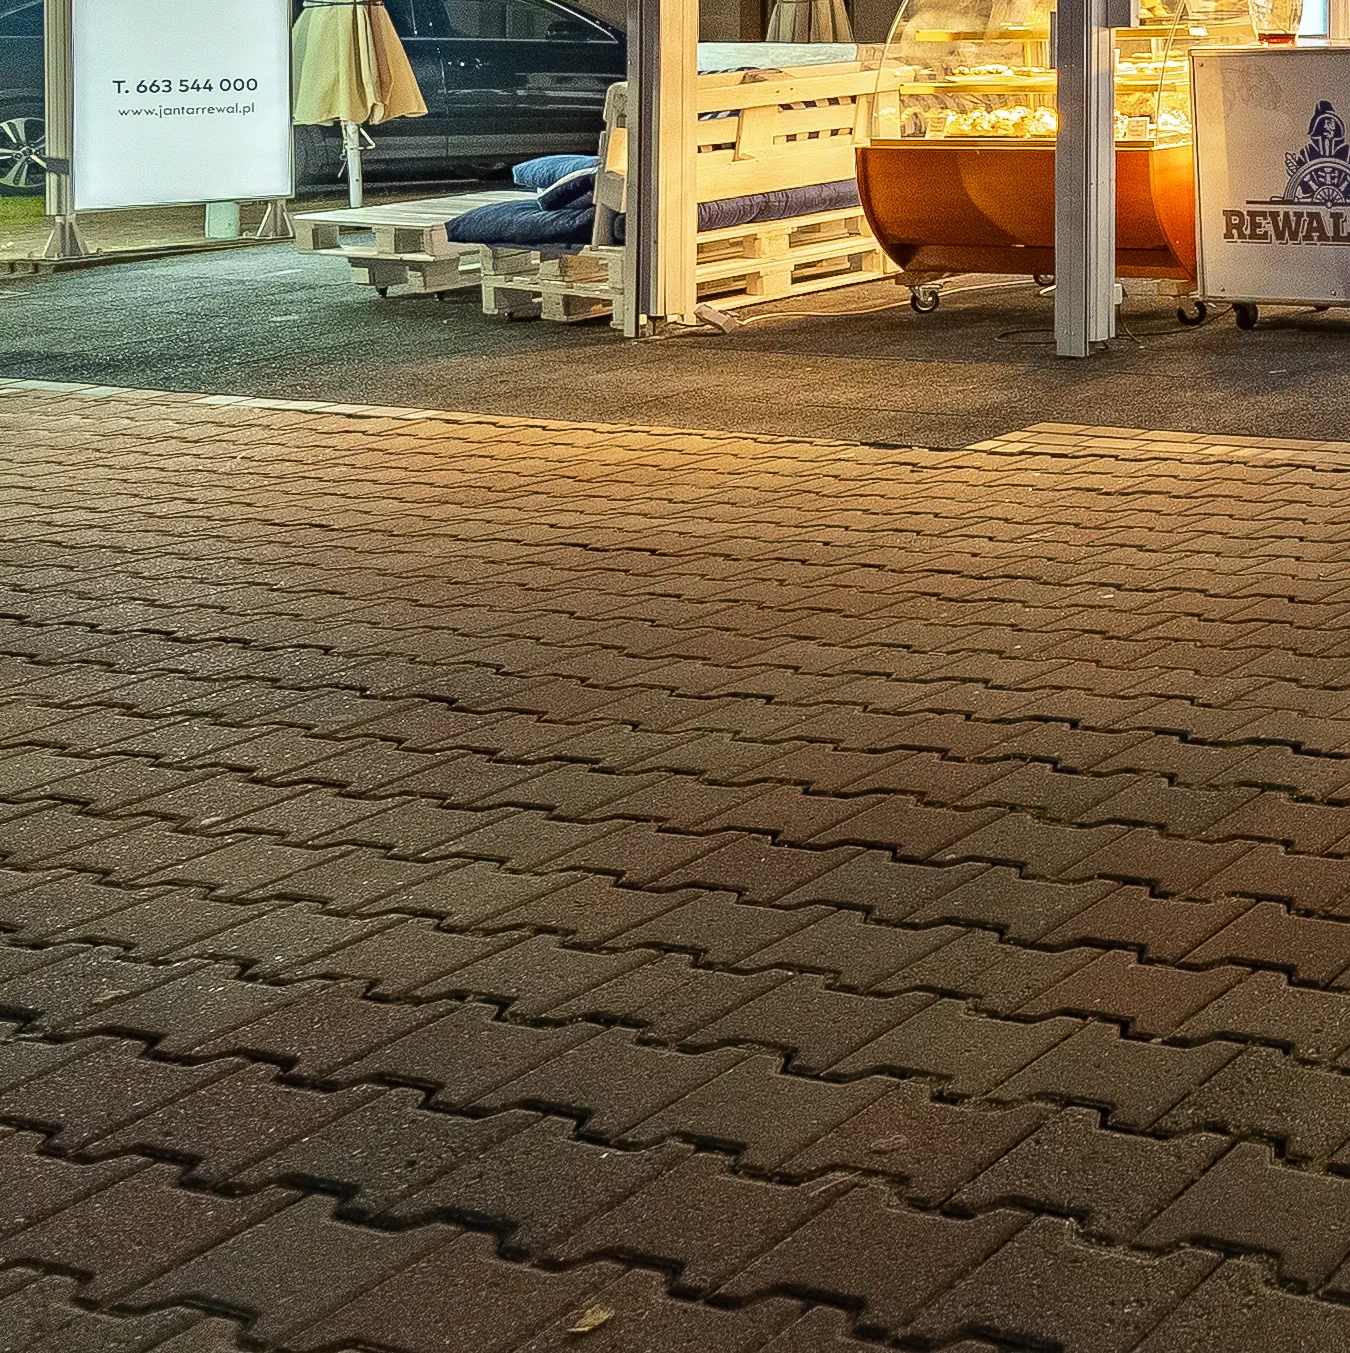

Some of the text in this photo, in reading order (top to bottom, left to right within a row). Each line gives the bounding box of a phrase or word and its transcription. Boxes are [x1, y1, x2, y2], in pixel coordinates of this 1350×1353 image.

[112, 78, 258, 94] T. 663 544 000
[118, 102, 256, 119] www.jantarrewal.pl
